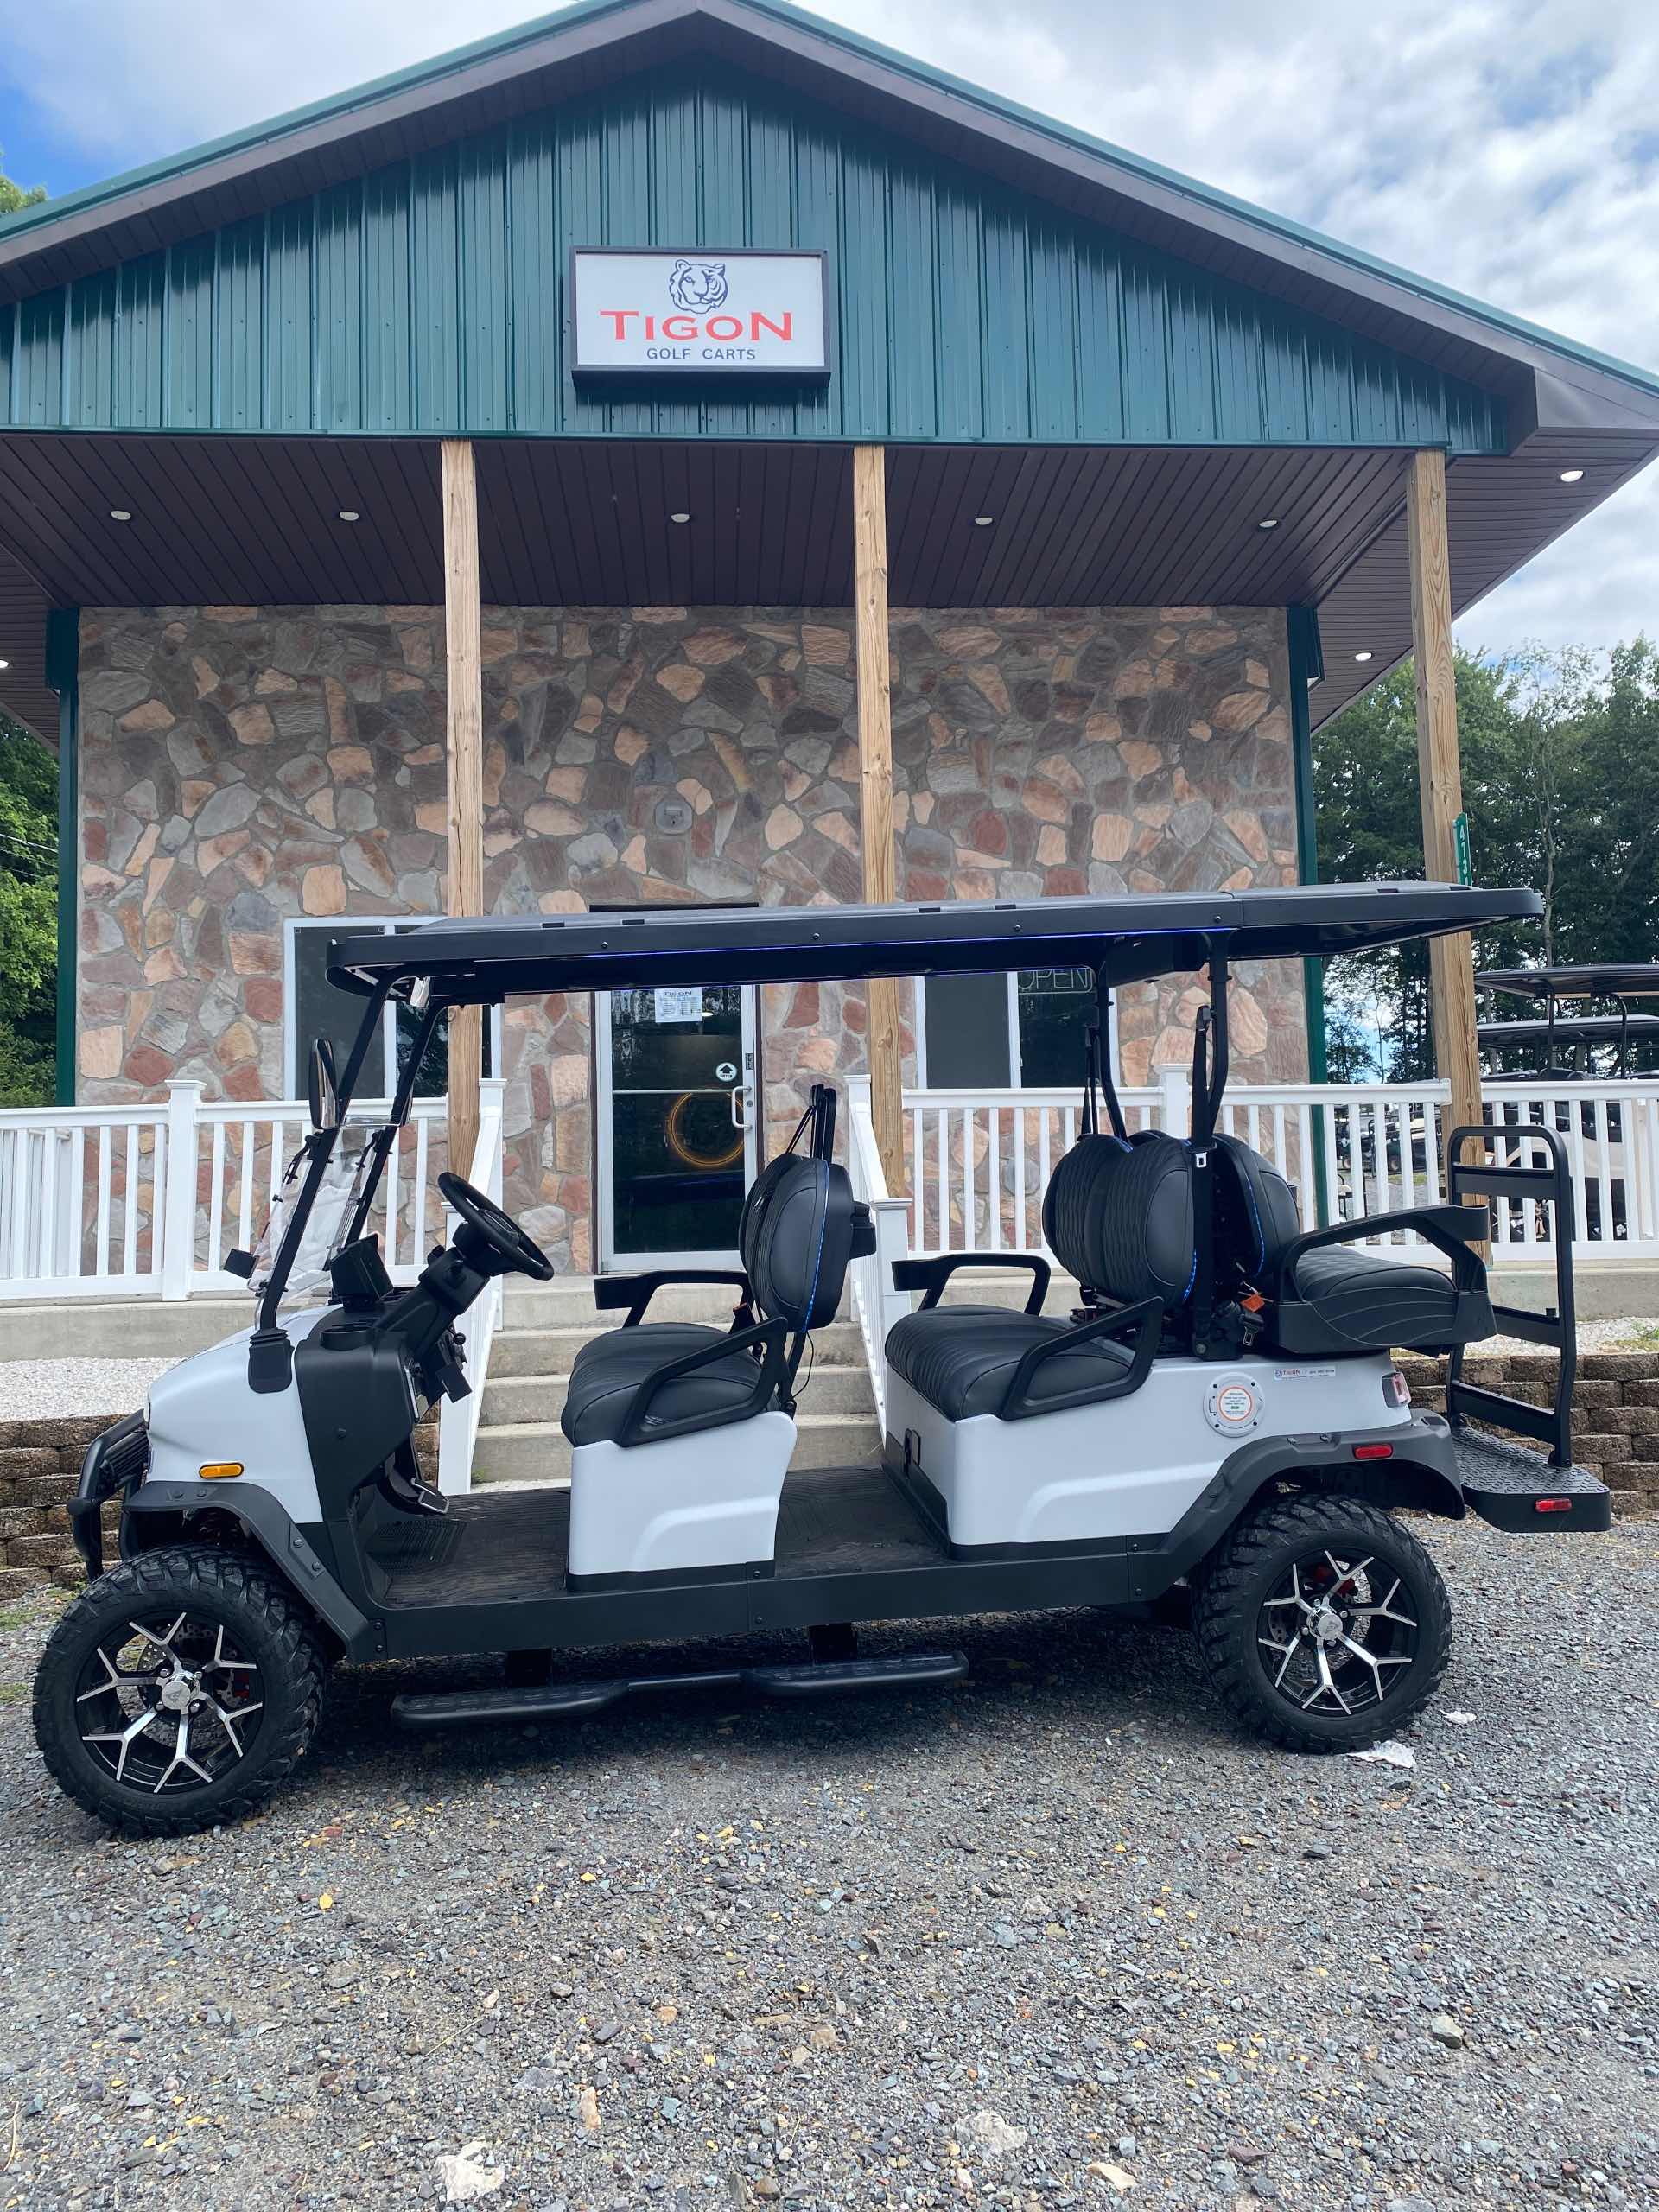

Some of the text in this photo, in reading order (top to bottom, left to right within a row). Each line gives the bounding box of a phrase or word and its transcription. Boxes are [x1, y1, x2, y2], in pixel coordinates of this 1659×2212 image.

[600, 310, 793, 341] TIGON
[646, 347, 756, 360] GOLF CARTS
[1019, 968, 1088, 990] OPEN
